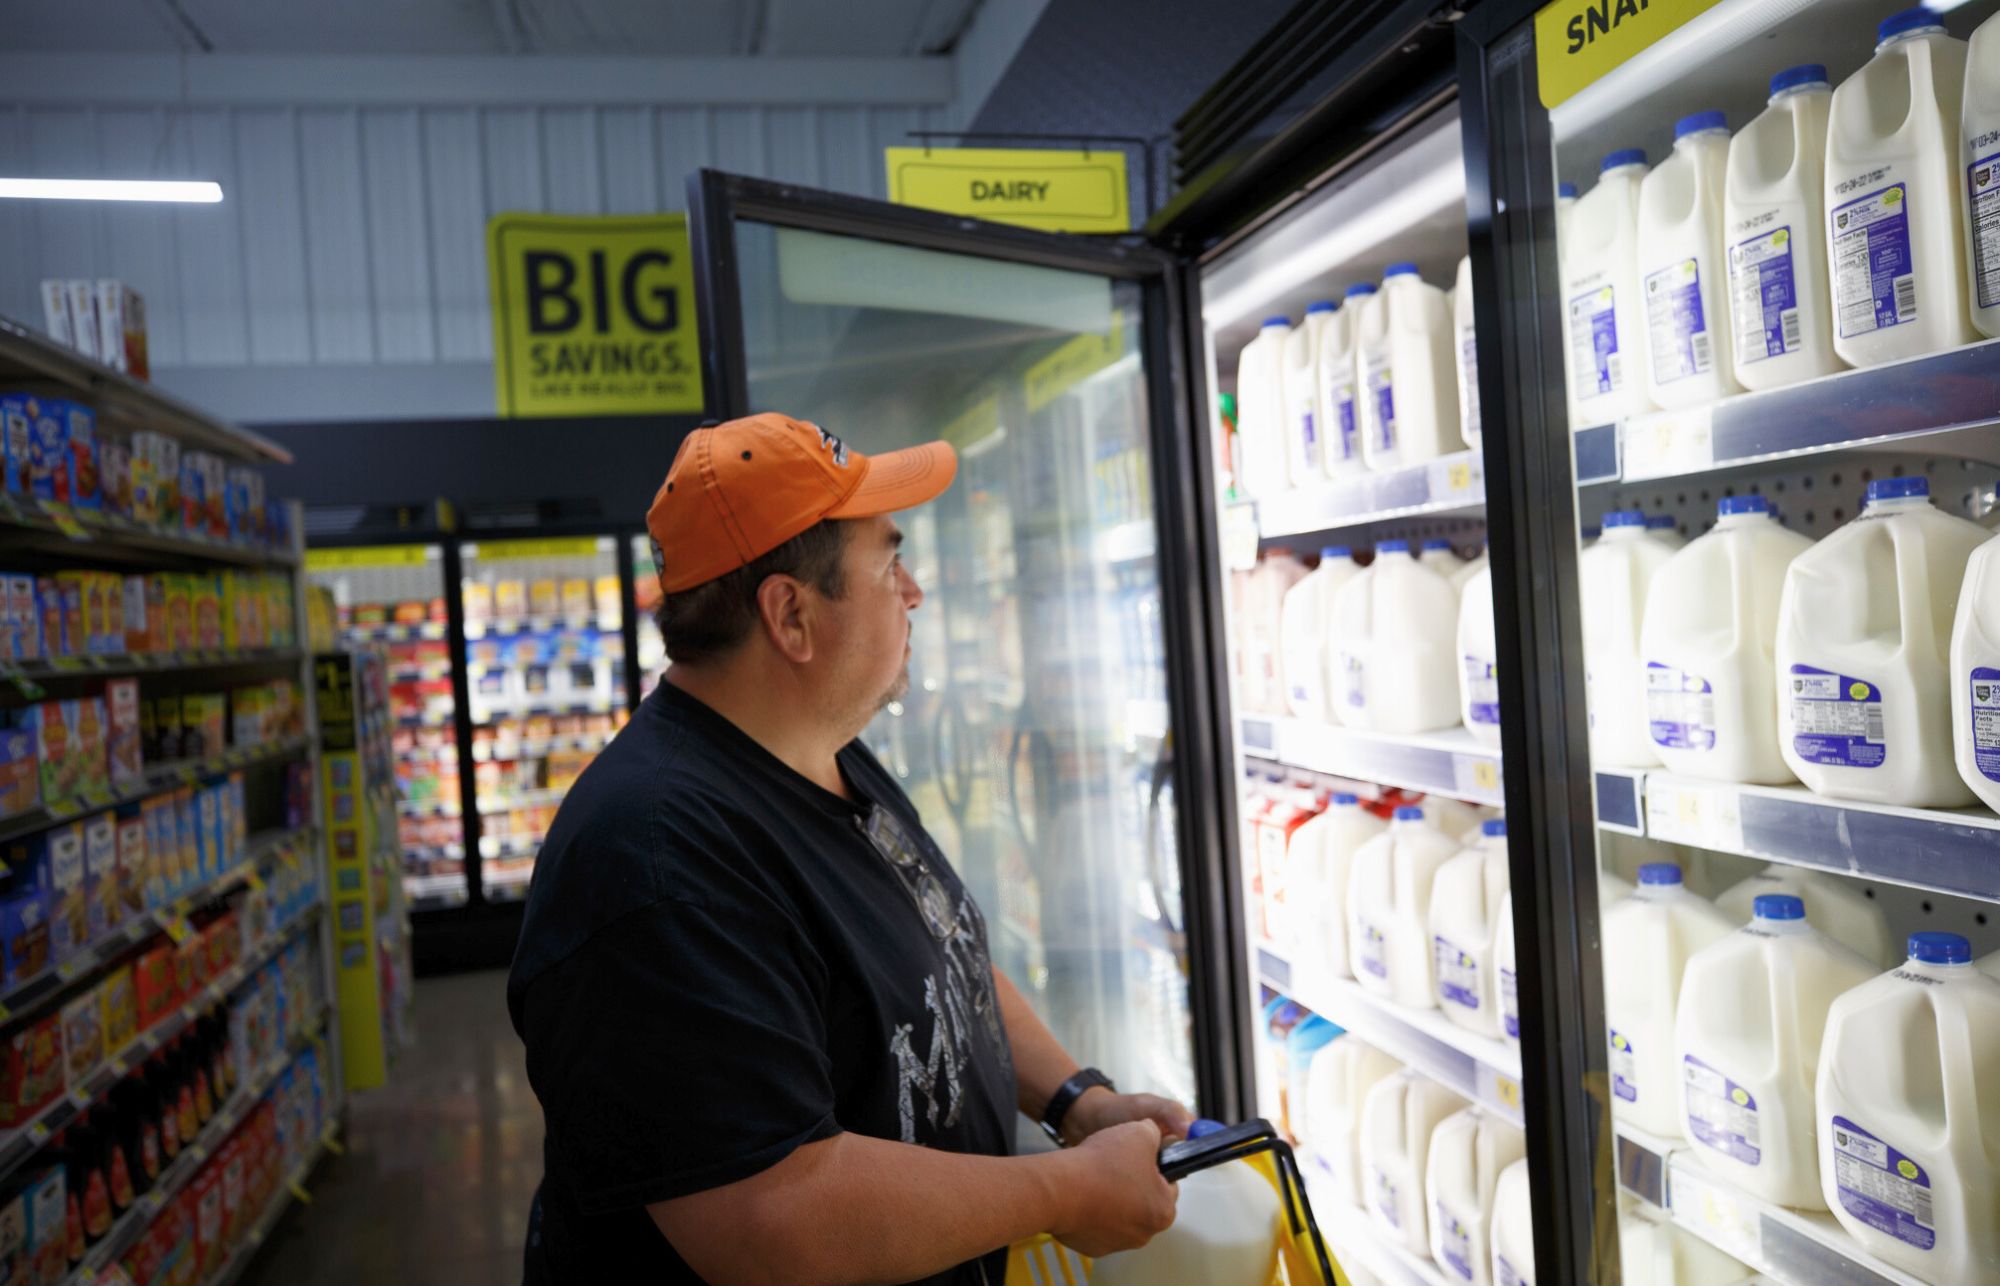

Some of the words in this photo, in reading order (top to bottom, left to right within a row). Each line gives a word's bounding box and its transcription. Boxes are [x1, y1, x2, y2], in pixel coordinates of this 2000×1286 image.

[1567, 0, 1649, 55] SNA
[969, 180, 1050, 202] DAIRY
[523, 249, 680, 335] BIG
[531, 342, 692, 376] SAVINGS.
